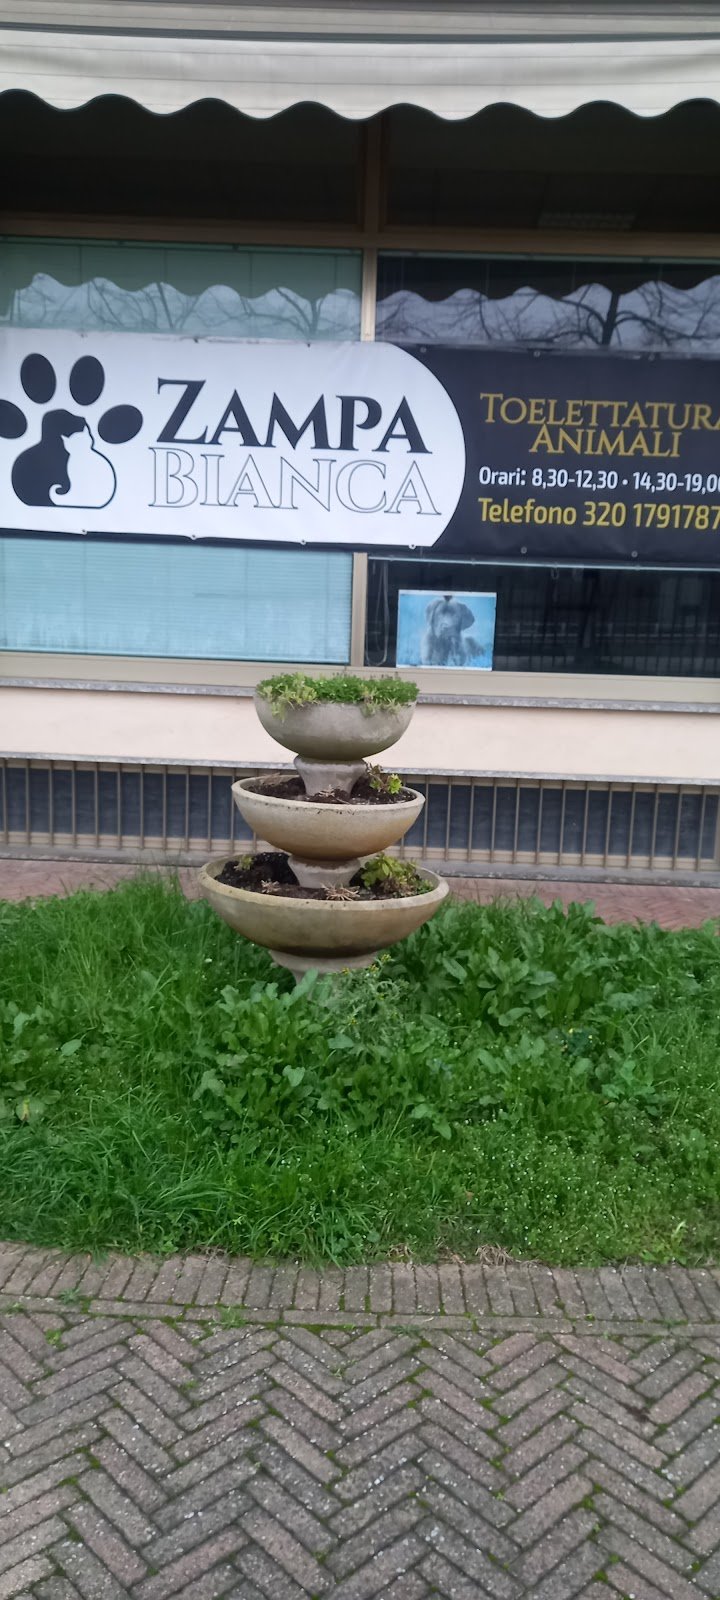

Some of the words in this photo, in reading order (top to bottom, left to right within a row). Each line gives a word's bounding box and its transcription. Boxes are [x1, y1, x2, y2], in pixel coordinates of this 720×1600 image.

[156, 377, 433, 454] ZAMPA
[480, 392, 720, 431] TOELETTATUR
[528, 424, 683, 457] ANIMALI
[148, 447, 442, 515] BIANCA
[478, 466, 526, 486] Orari:
[532, 468, 618, 491] 8,30-12,30
[632, 471, 720, 494] 14,30-19,0
[478, 497, 577, 525] Telefono
[582, 501, 627, 527] 320
[633, 503, 720, 530] 1791787
